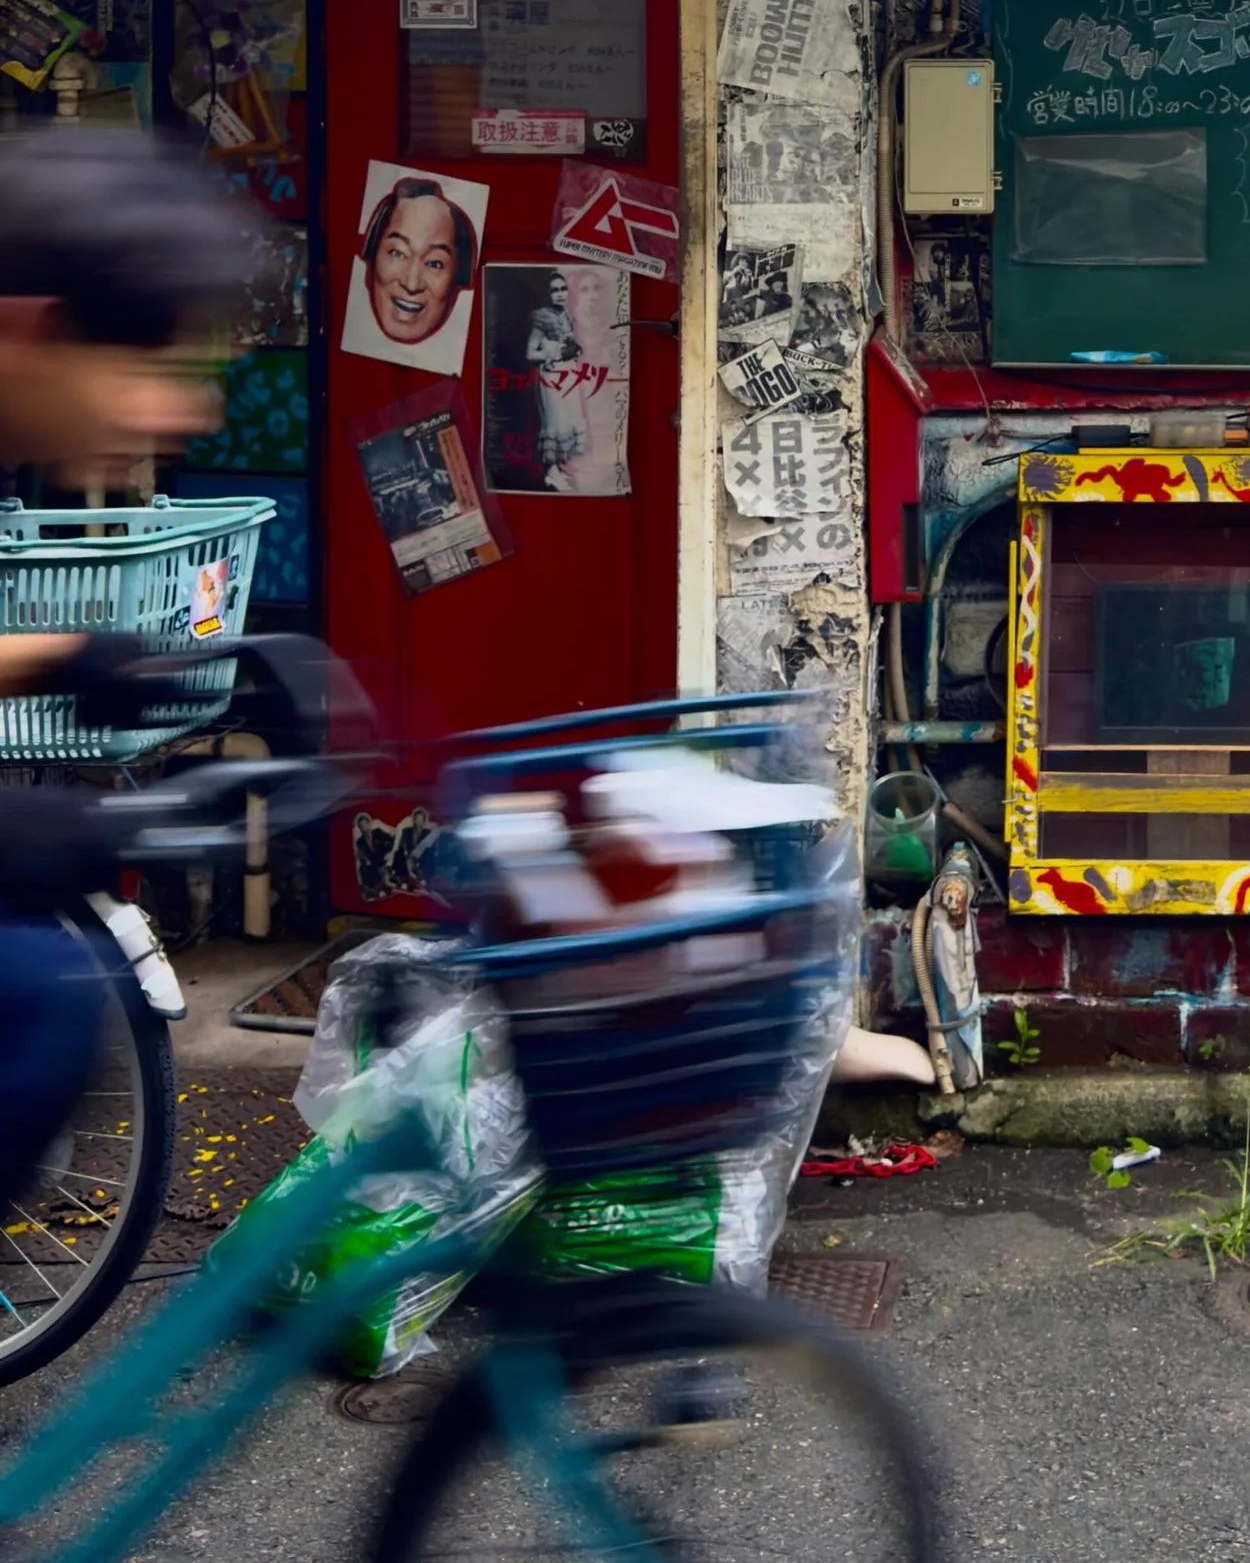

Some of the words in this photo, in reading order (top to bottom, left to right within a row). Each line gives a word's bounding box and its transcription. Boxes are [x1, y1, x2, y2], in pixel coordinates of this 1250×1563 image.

[478, 120, 562, 144] 取扱注意
[735, 351, 766, 380] THE
